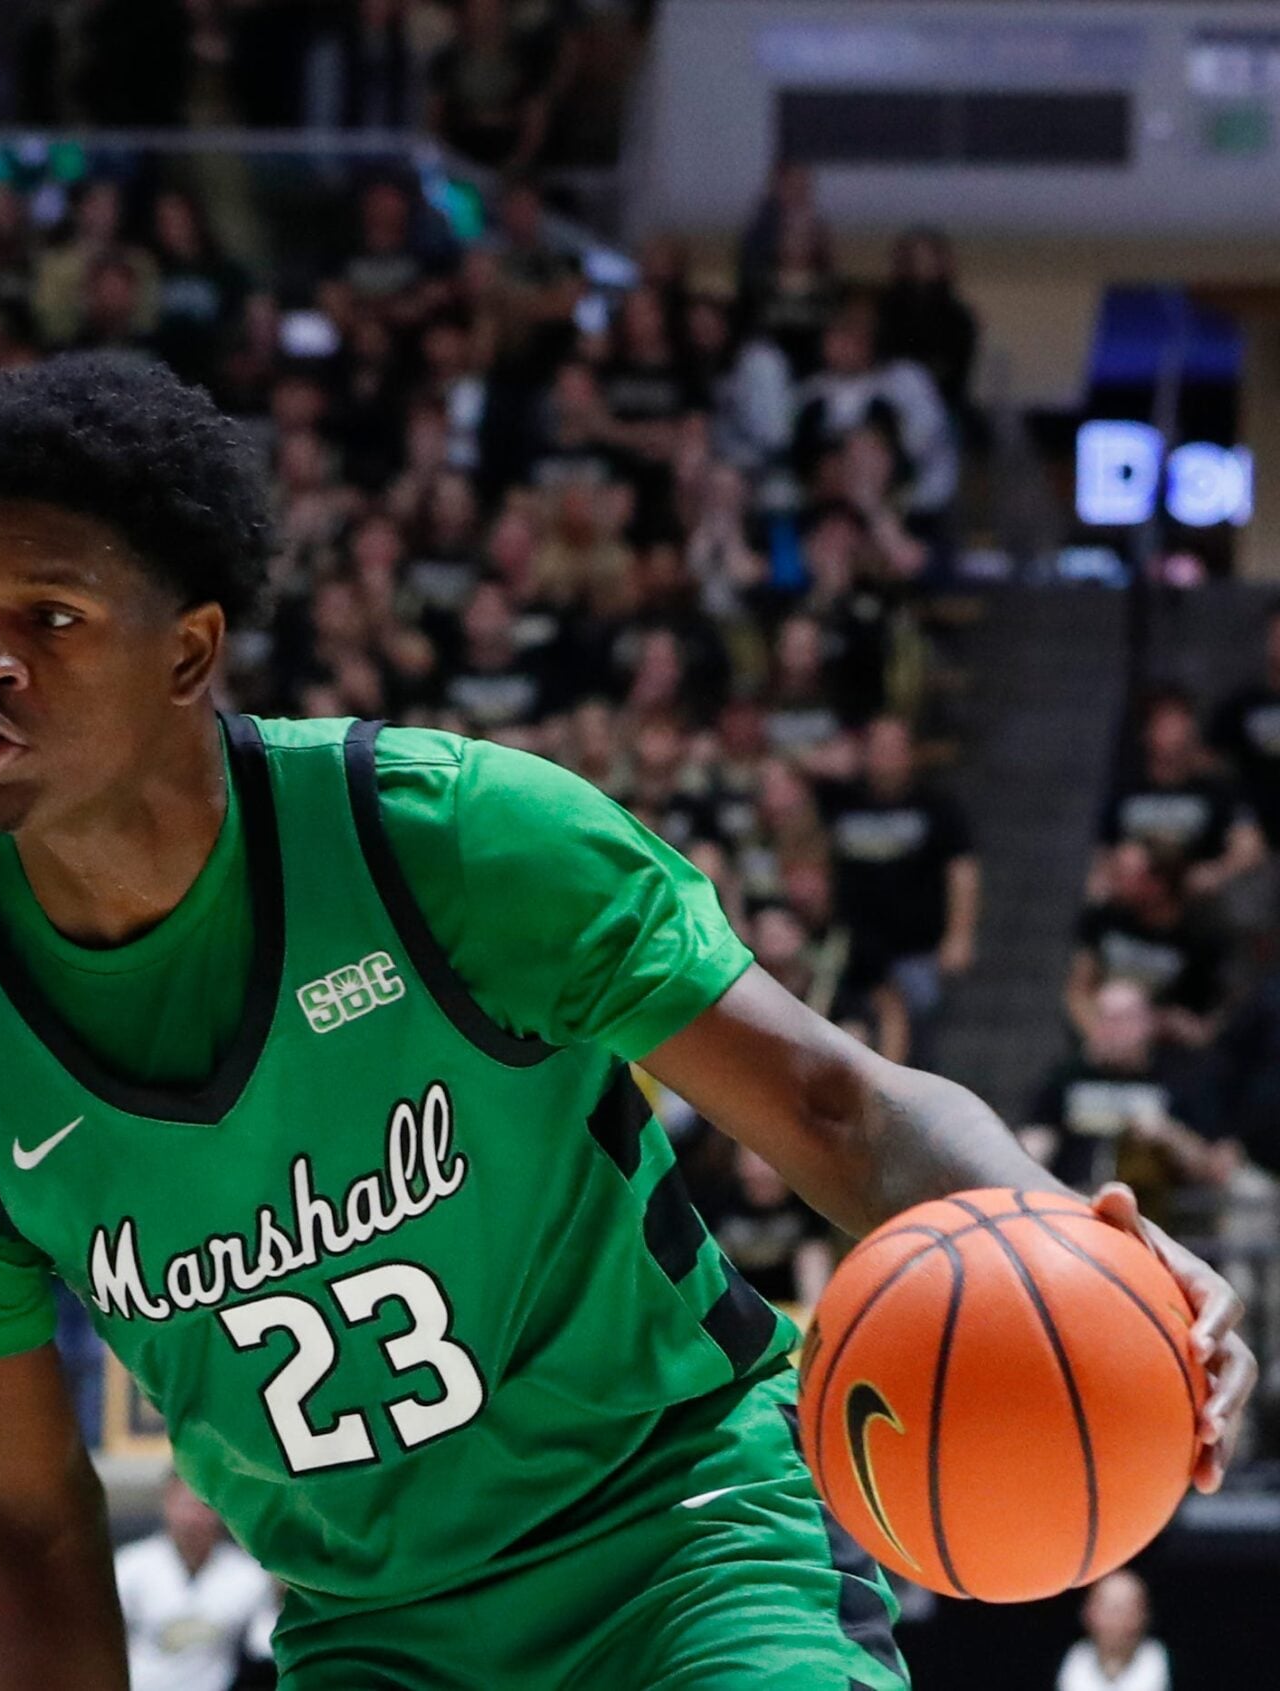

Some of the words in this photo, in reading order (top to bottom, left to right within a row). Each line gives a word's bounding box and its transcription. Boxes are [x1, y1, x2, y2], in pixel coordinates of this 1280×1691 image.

[296, 951, 405, 1033] SBC
[88, 1081, 466, 1320] Marshall
[219, 1262, 487, 1476] 23
